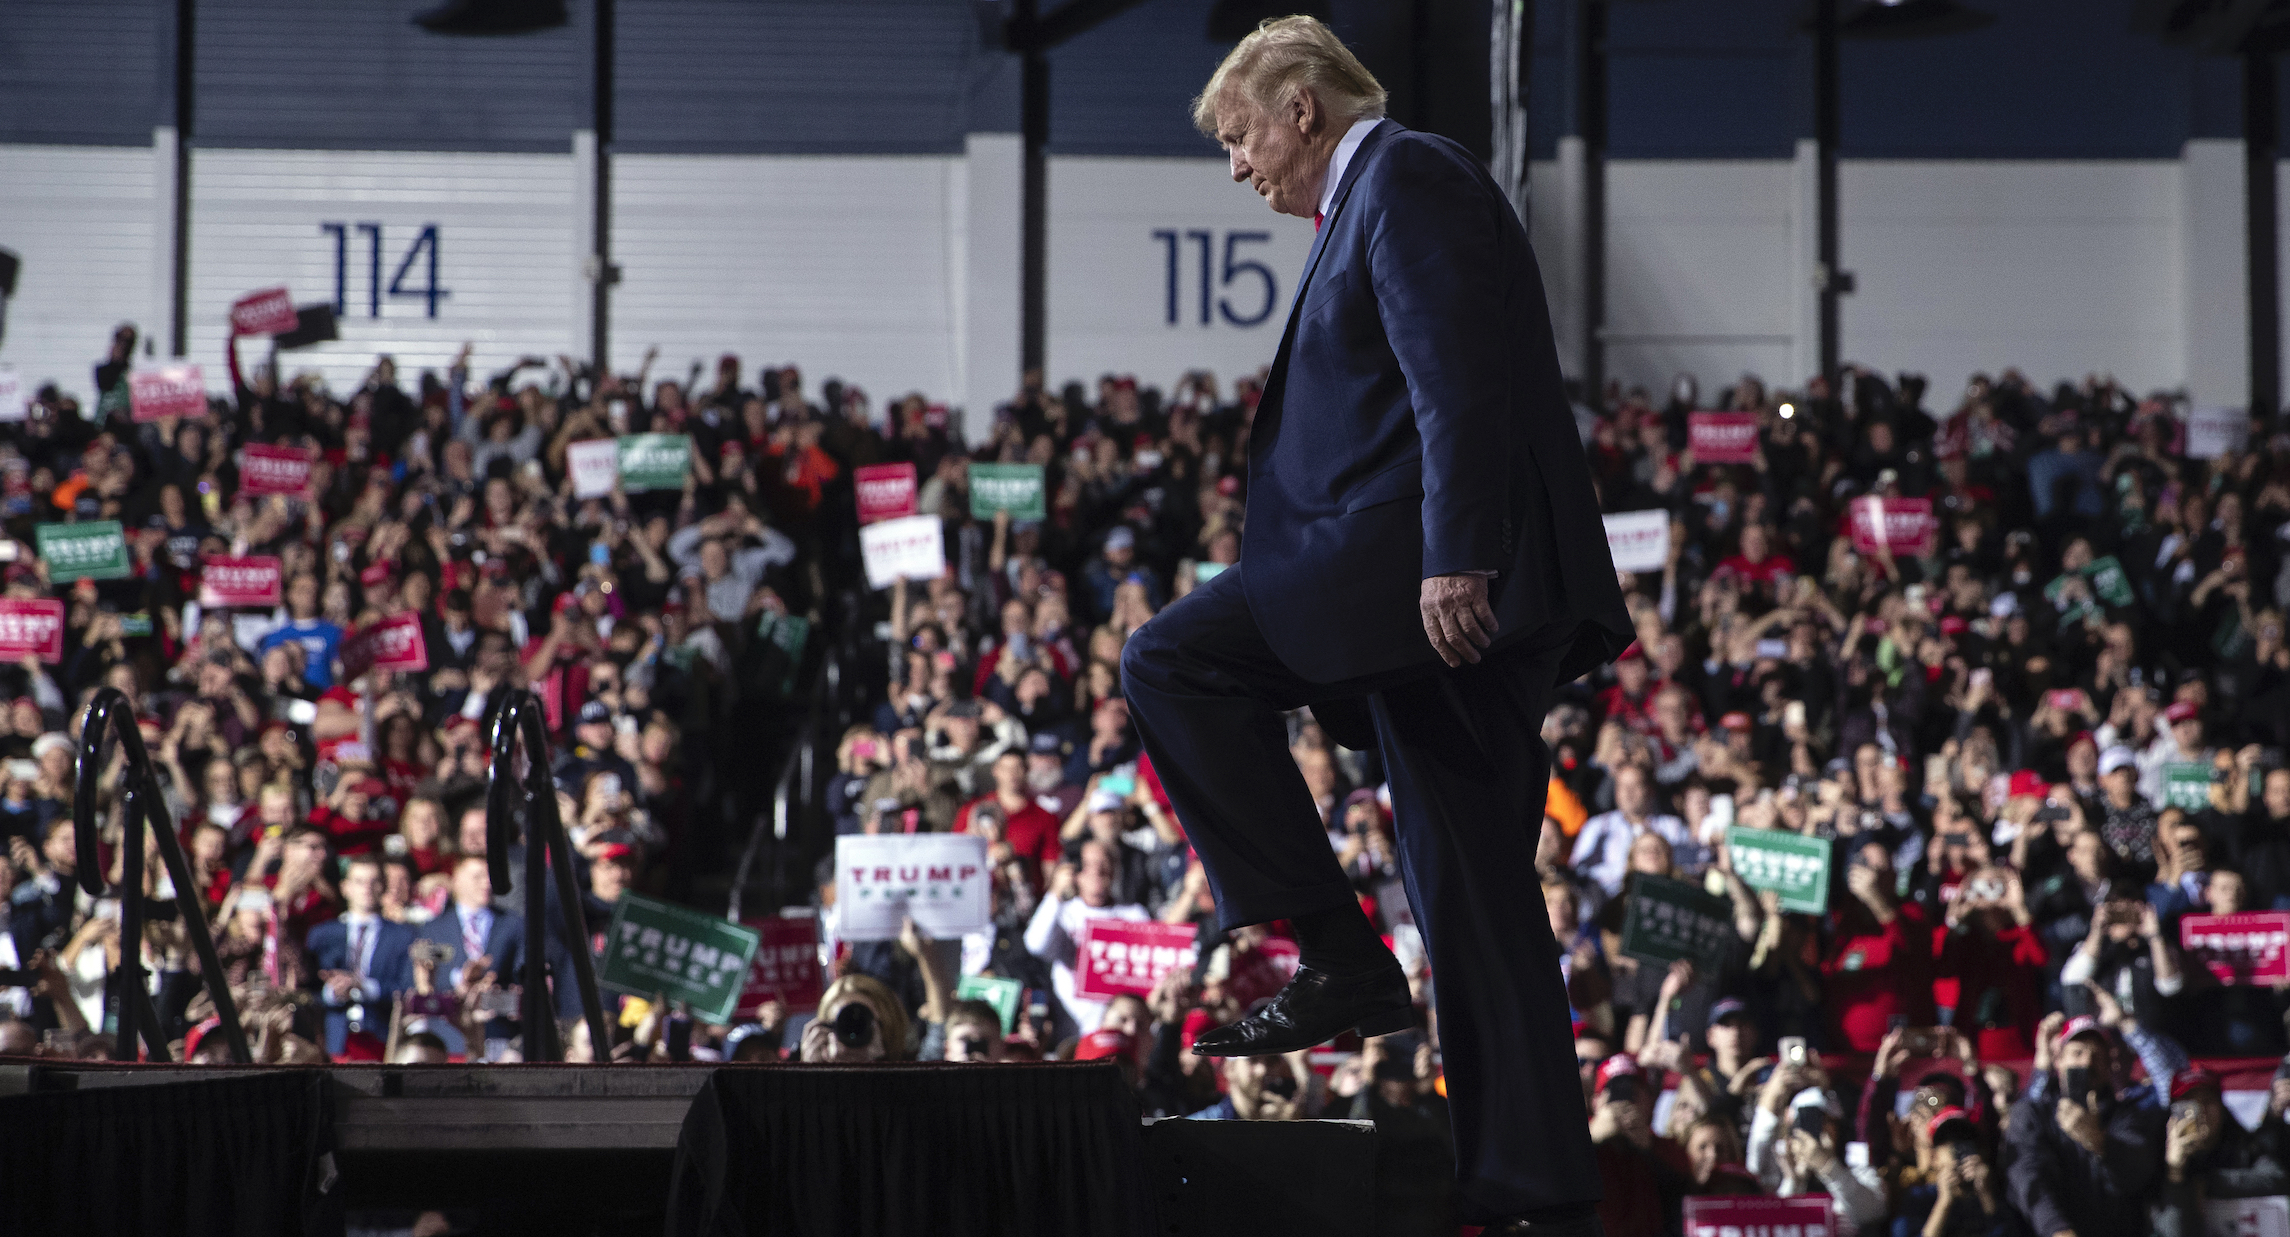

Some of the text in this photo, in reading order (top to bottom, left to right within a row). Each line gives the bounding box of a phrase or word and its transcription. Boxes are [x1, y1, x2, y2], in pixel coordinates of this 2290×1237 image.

[321, 222, 451, 319] 114
[1151, 230, 1279, 328] 115
[851, 864, 977, 884] TRUMP
[621, 919, 744, 973] TRUMP
[1088, 939, 1198, 967] TRUMP
